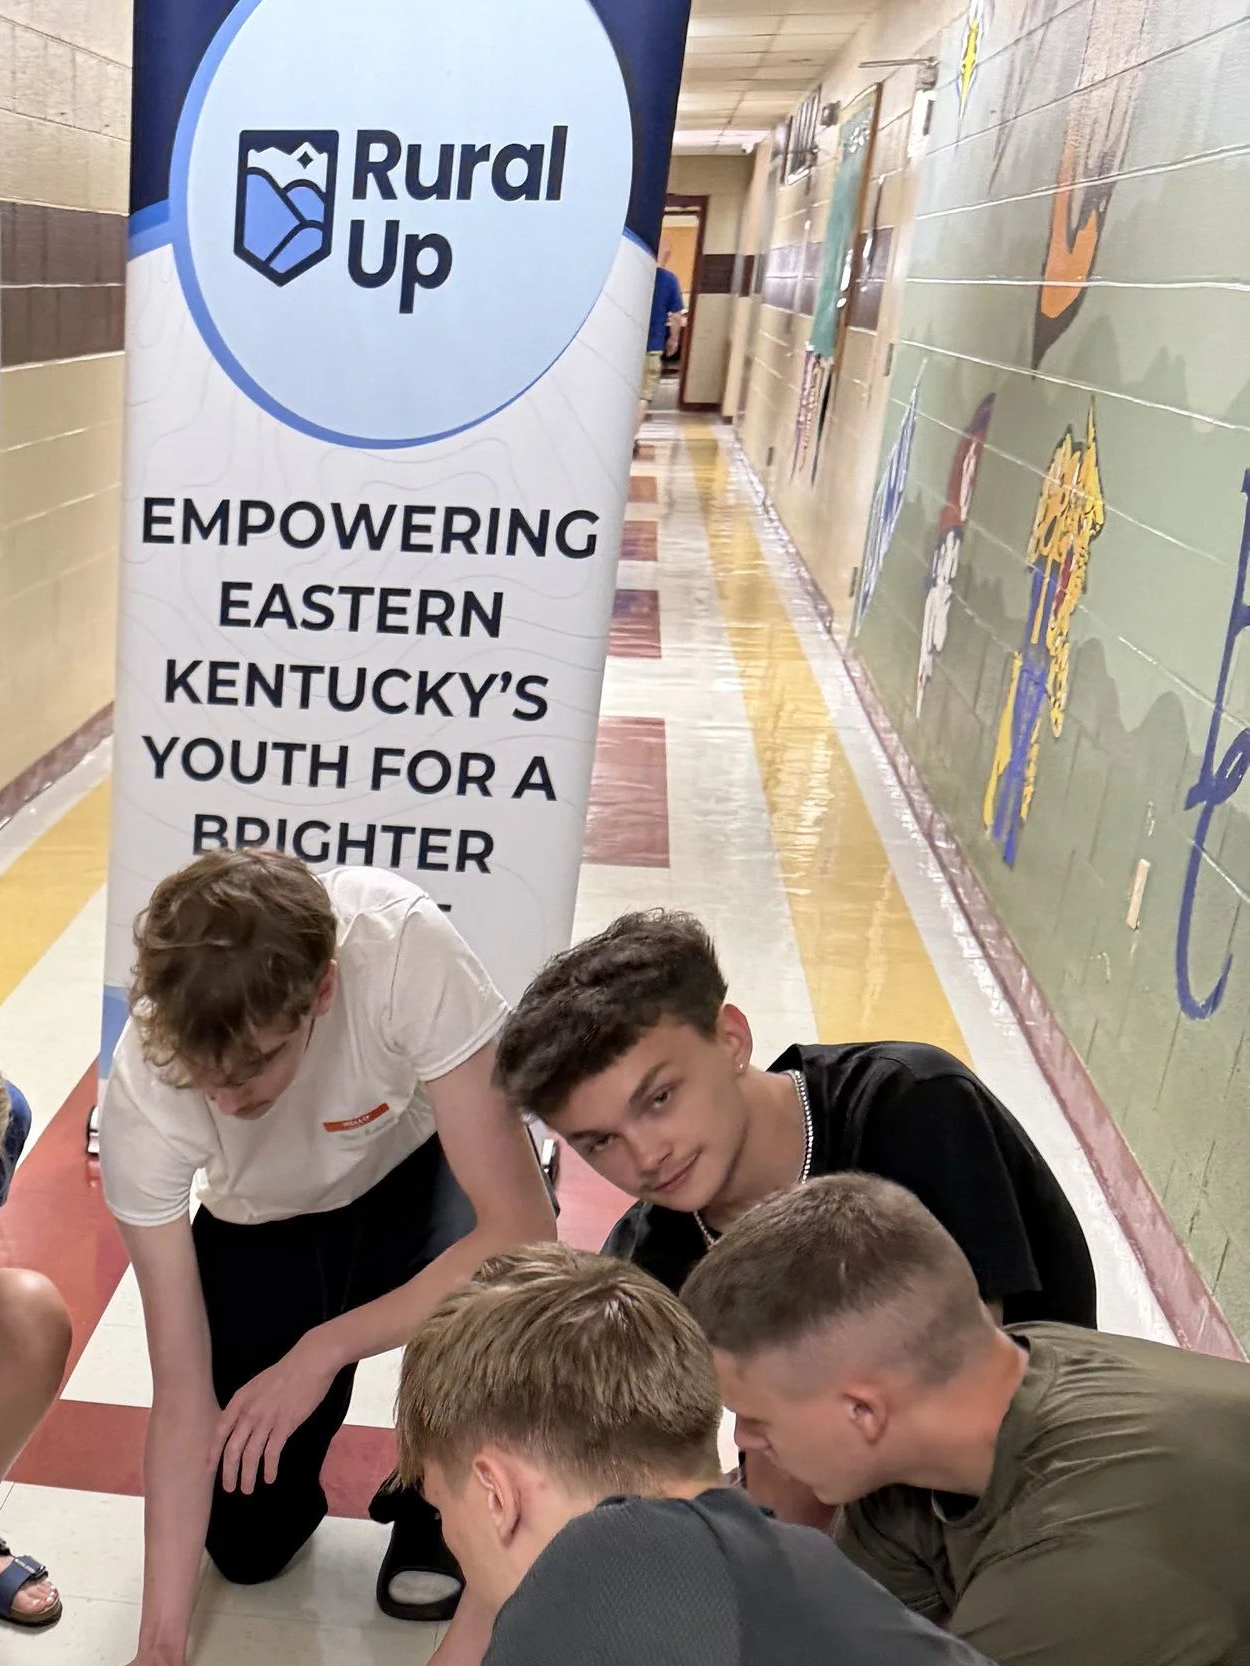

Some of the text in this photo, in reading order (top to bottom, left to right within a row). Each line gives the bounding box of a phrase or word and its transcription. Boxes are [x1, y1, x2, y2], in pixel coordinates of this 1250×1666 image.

[352, 125, 569, 202] Rural
[347, 219, 453, 314] Up
[142, 496, 600, 560] EMPOWERING
[219, 581, 504, 639] EASTERN
[165, 658, 549, 722] KENTUCKY’S
[141, 735, 557, 802] YOUTH FOR A
